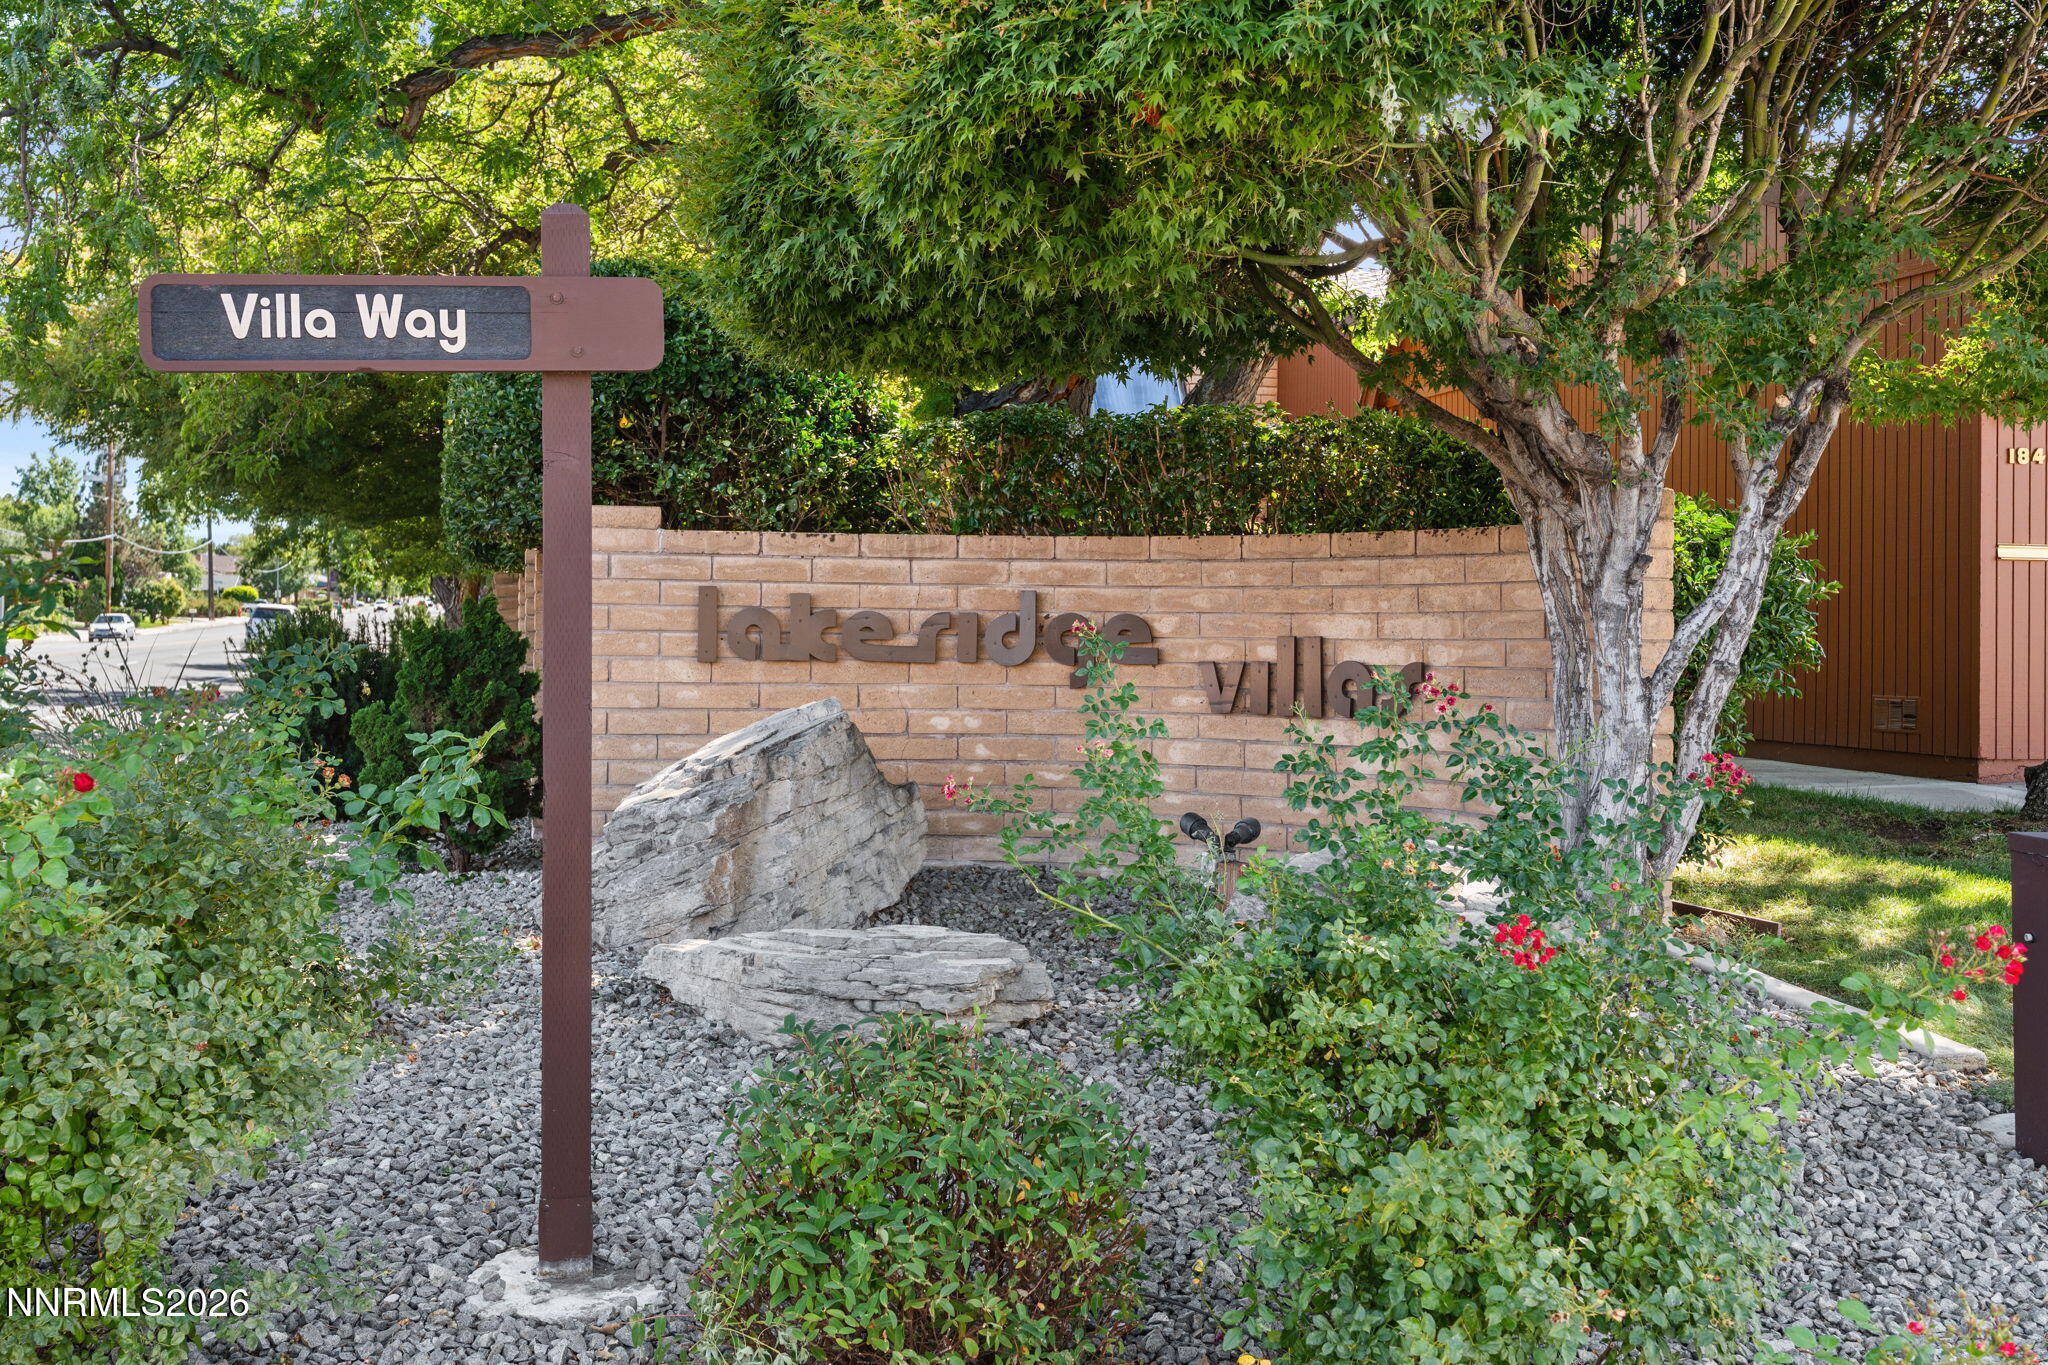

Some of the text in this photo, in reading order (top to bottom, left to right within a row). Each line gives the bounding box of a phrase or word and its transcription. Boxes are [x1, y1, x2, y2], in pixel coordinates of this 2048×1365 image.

[220, 293, 467, 354] Villa Way
[2008, 447, 2046, 465] 184
